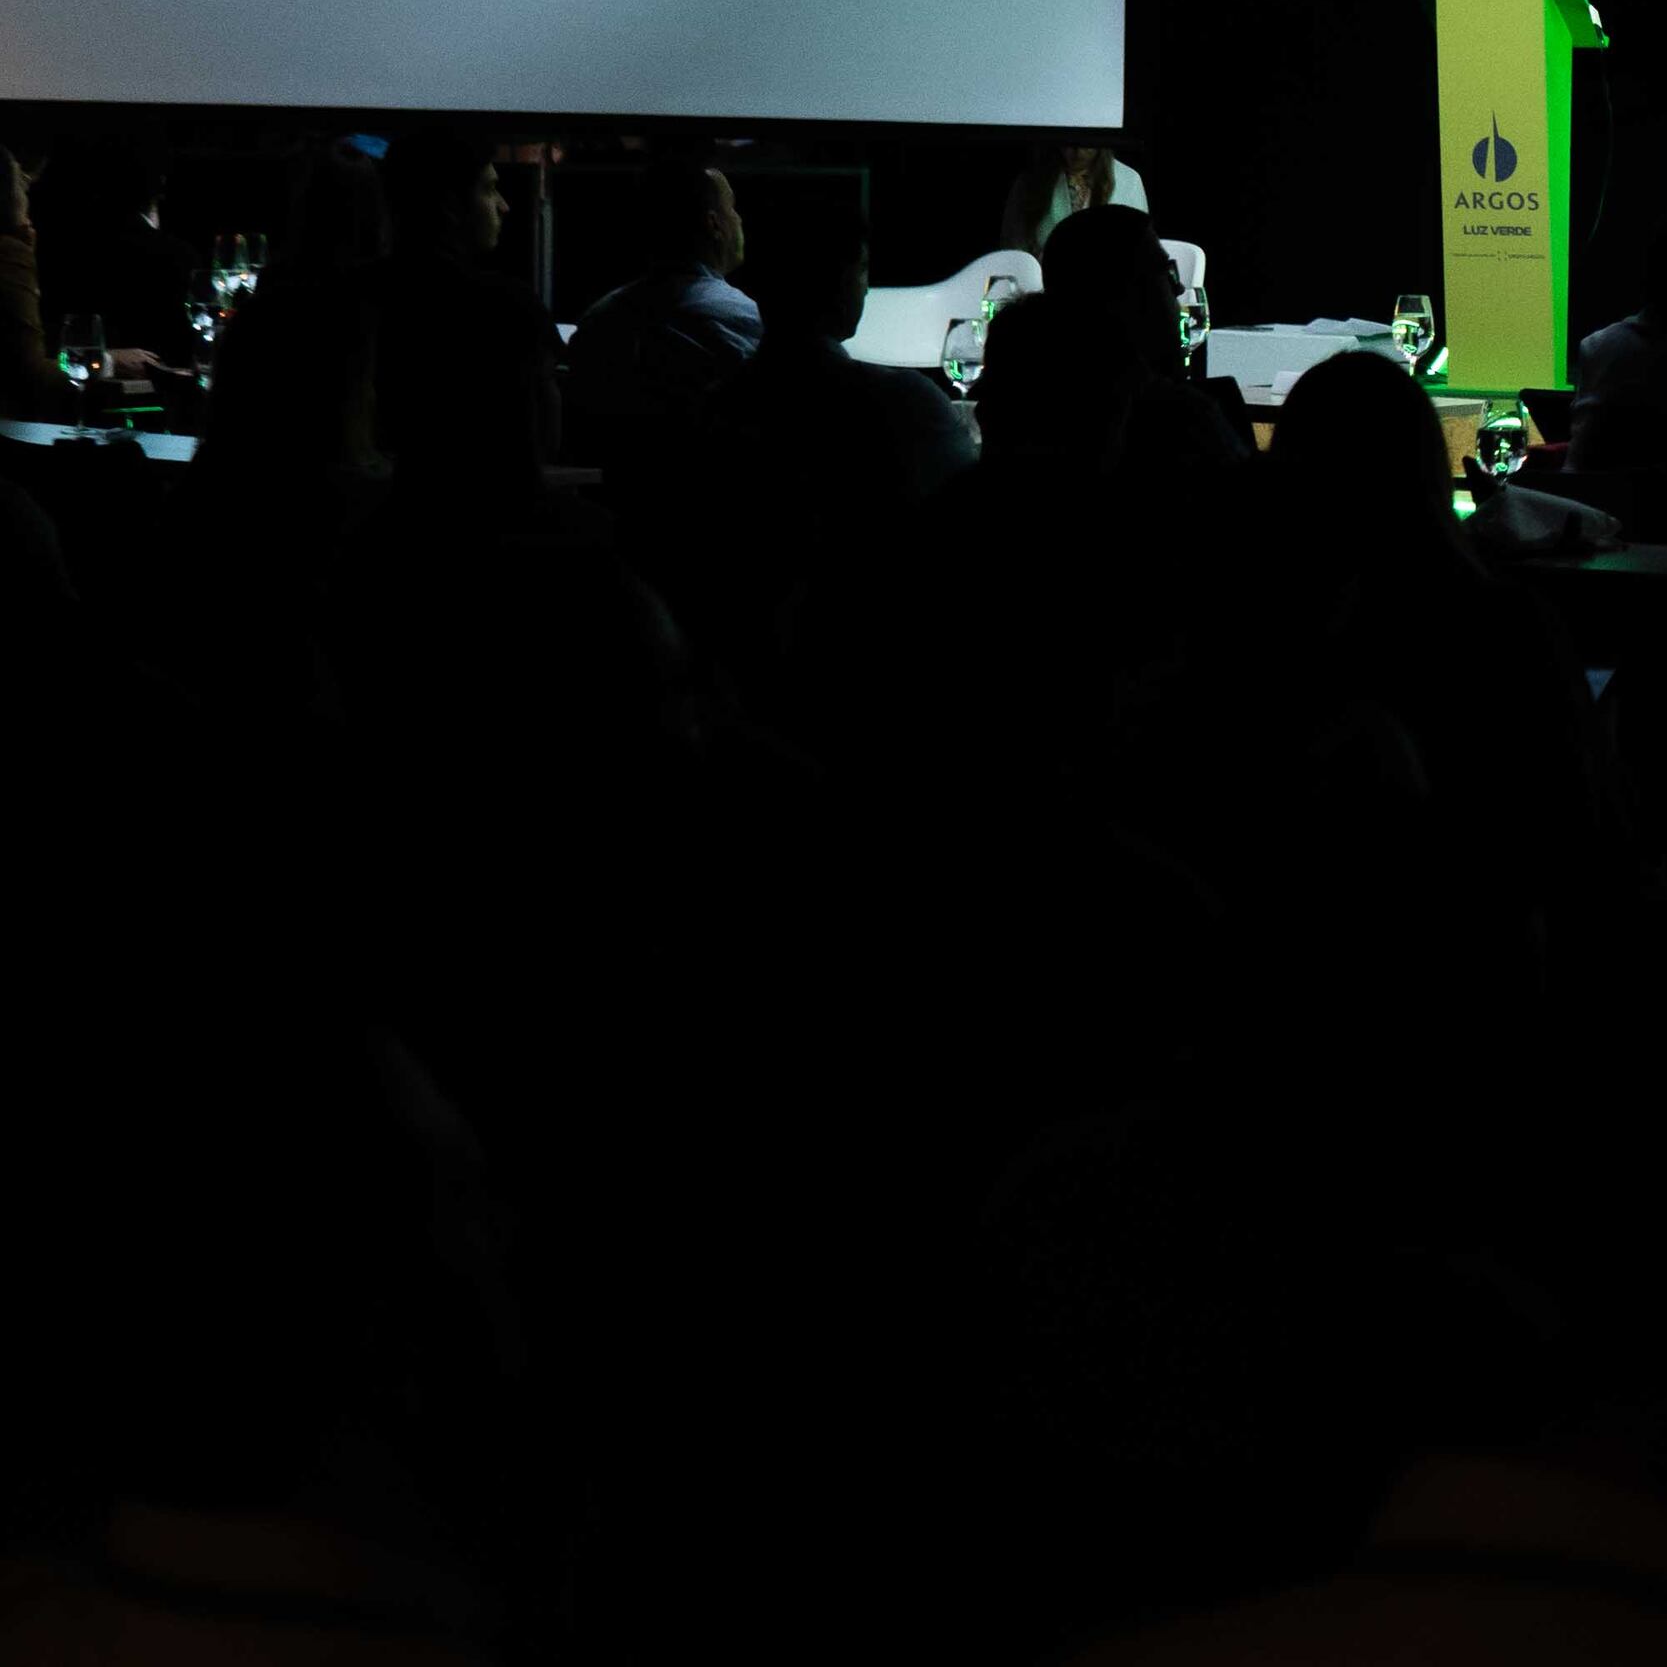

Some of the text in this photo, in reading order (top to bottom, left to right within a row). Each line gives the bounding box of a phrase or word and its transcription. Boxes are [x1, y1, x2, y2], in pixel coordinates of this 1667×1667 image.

[1454, 192, 1540, 211] ARGOS
[1463, 225, 1532, 237] LUZ VERDE
